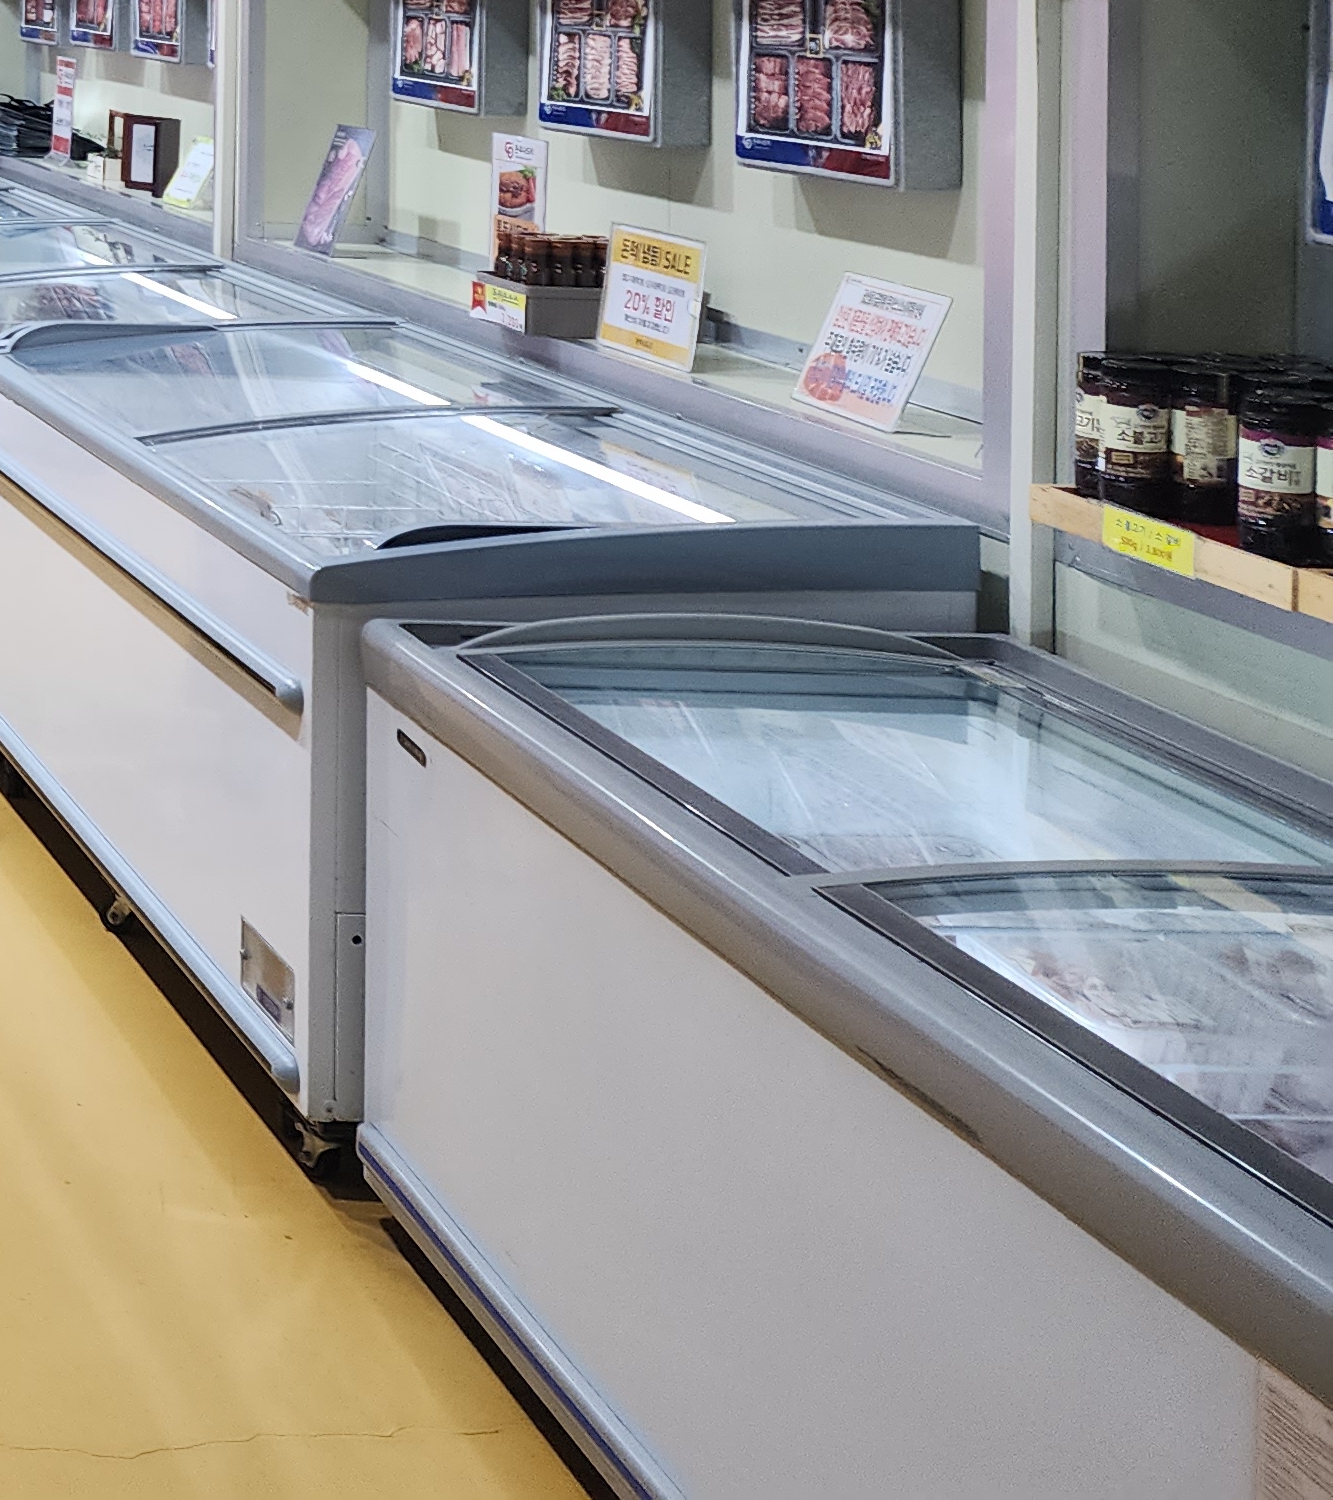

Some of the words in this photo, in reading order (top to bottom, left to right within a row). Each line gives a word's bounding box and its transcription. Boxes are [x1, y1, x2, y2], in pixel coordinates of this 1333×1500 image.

[663, 251, 692, 275] SALE
[624, 290, 650, 315] 20%
[654, 296, 675, 323] 할인
